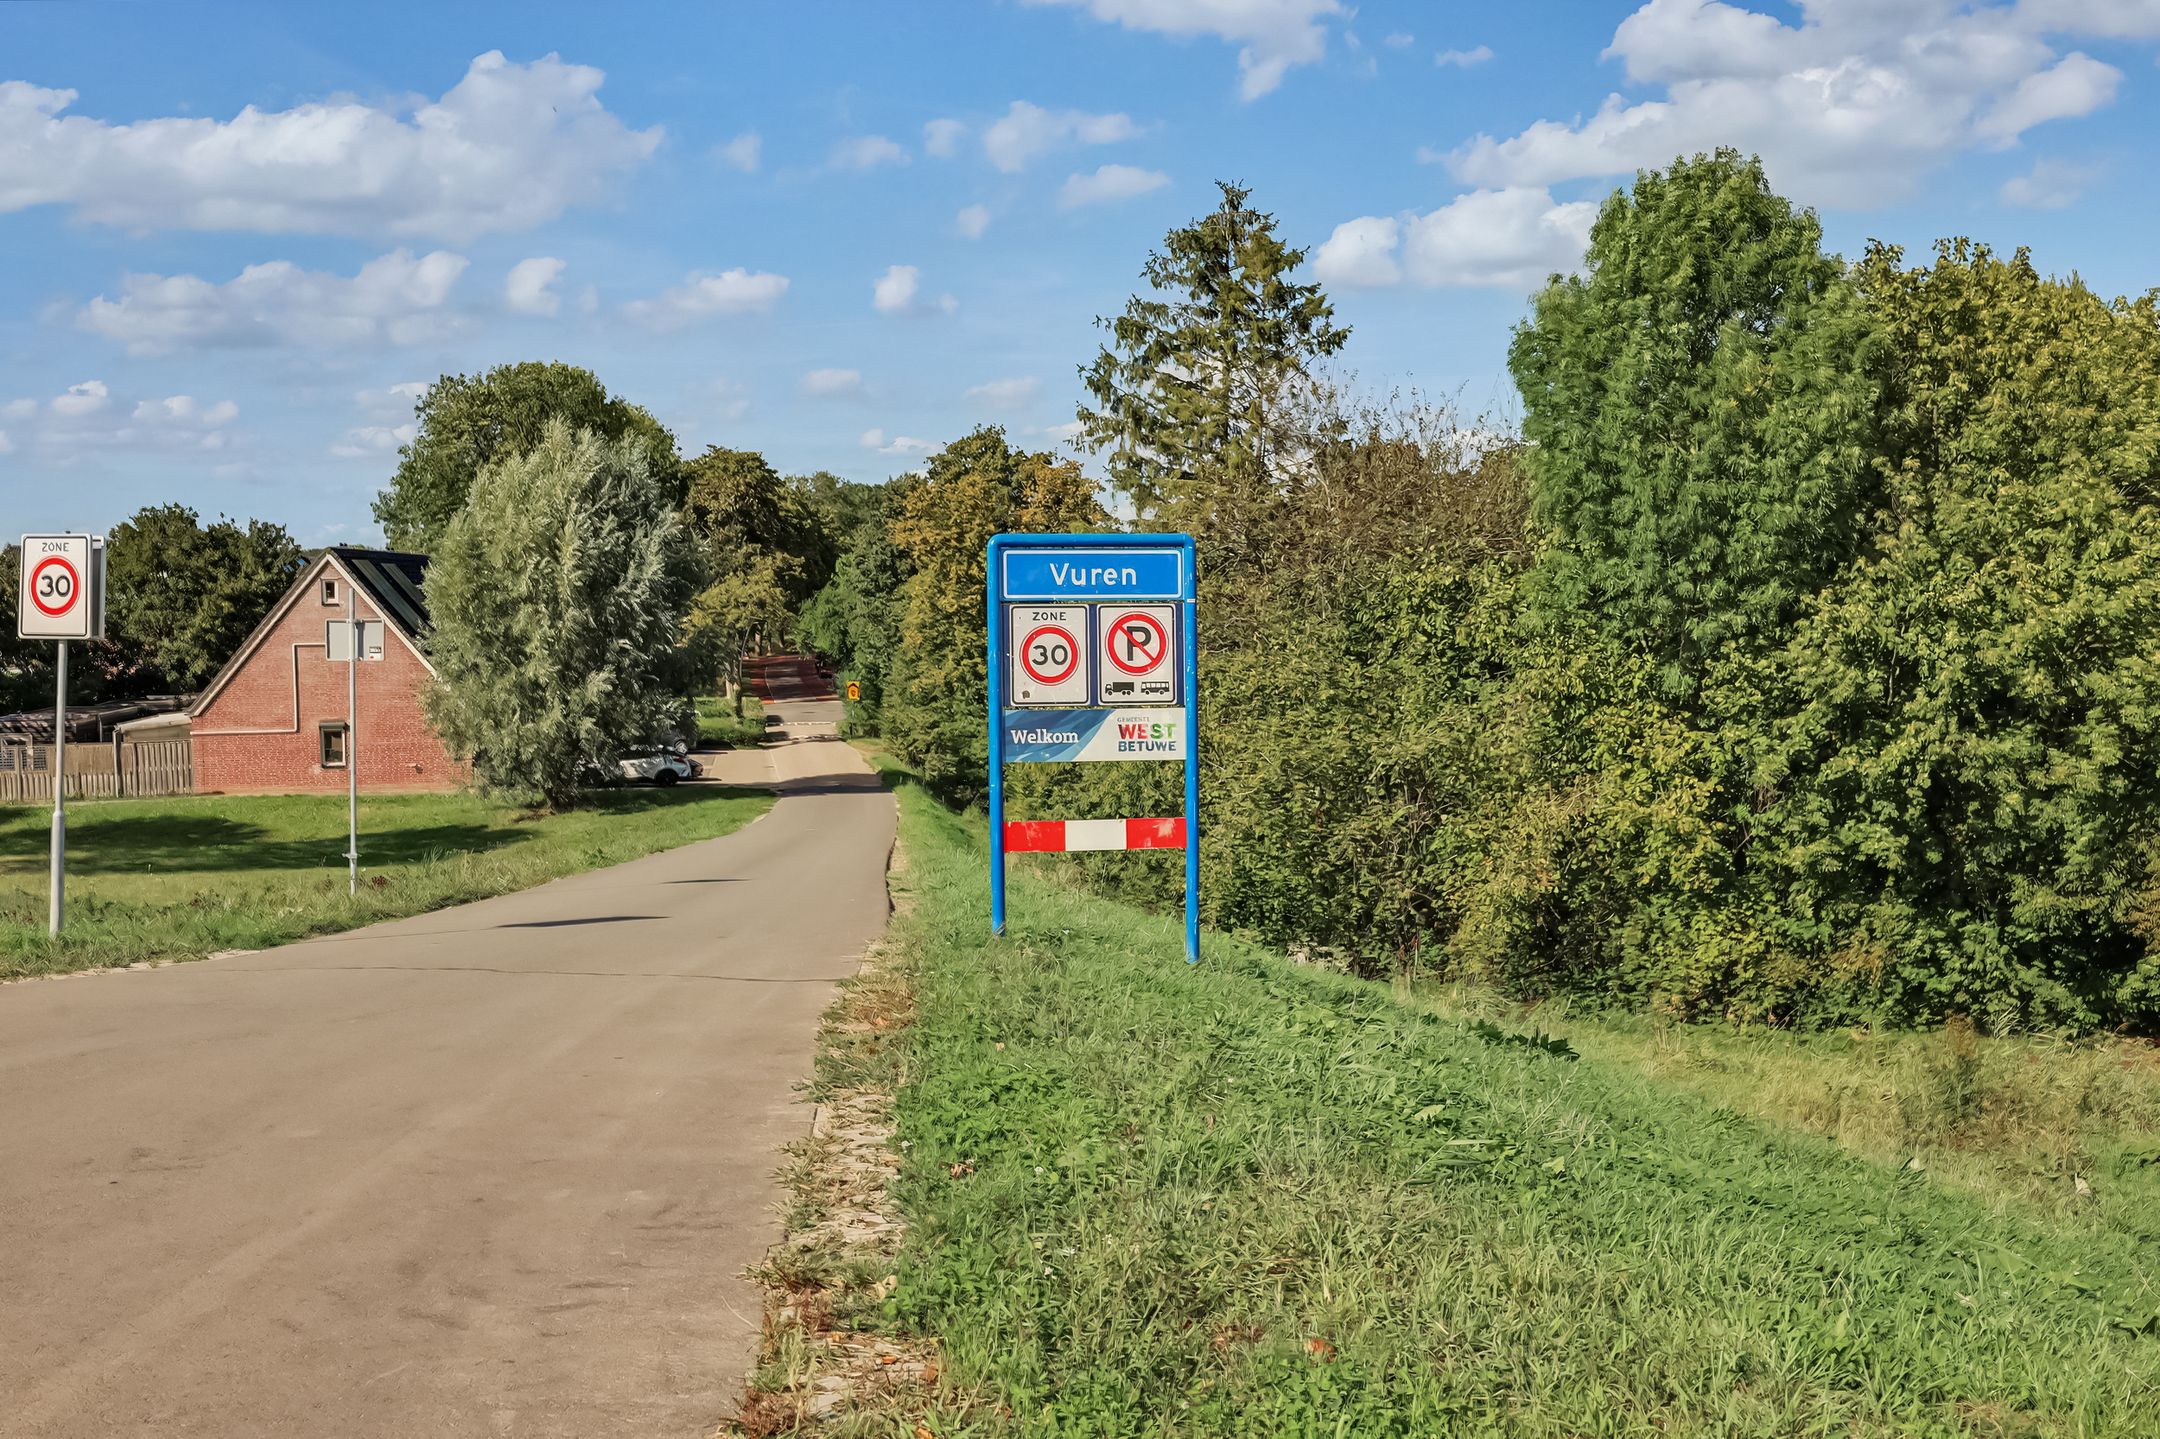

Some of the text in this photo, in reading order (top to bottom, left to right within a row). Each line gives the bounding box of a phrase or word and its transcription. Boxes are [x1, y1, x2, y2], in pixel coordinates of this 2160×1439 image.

[42, 542, 70, 552] ZONE
[1049, 562, 1137, 586] Vuren
[40, 575, 71, 597] 30
[1032, 611, 1067, 621] ZONE
[1126, 626, 1152, 661] P
[1032, 644, 1068, 665] 30
[1011, 728, 1079, 745] Welkom
[1118, 723, 1177, 740] WEST
[1118, 740, 1177, 752] BETUWE
